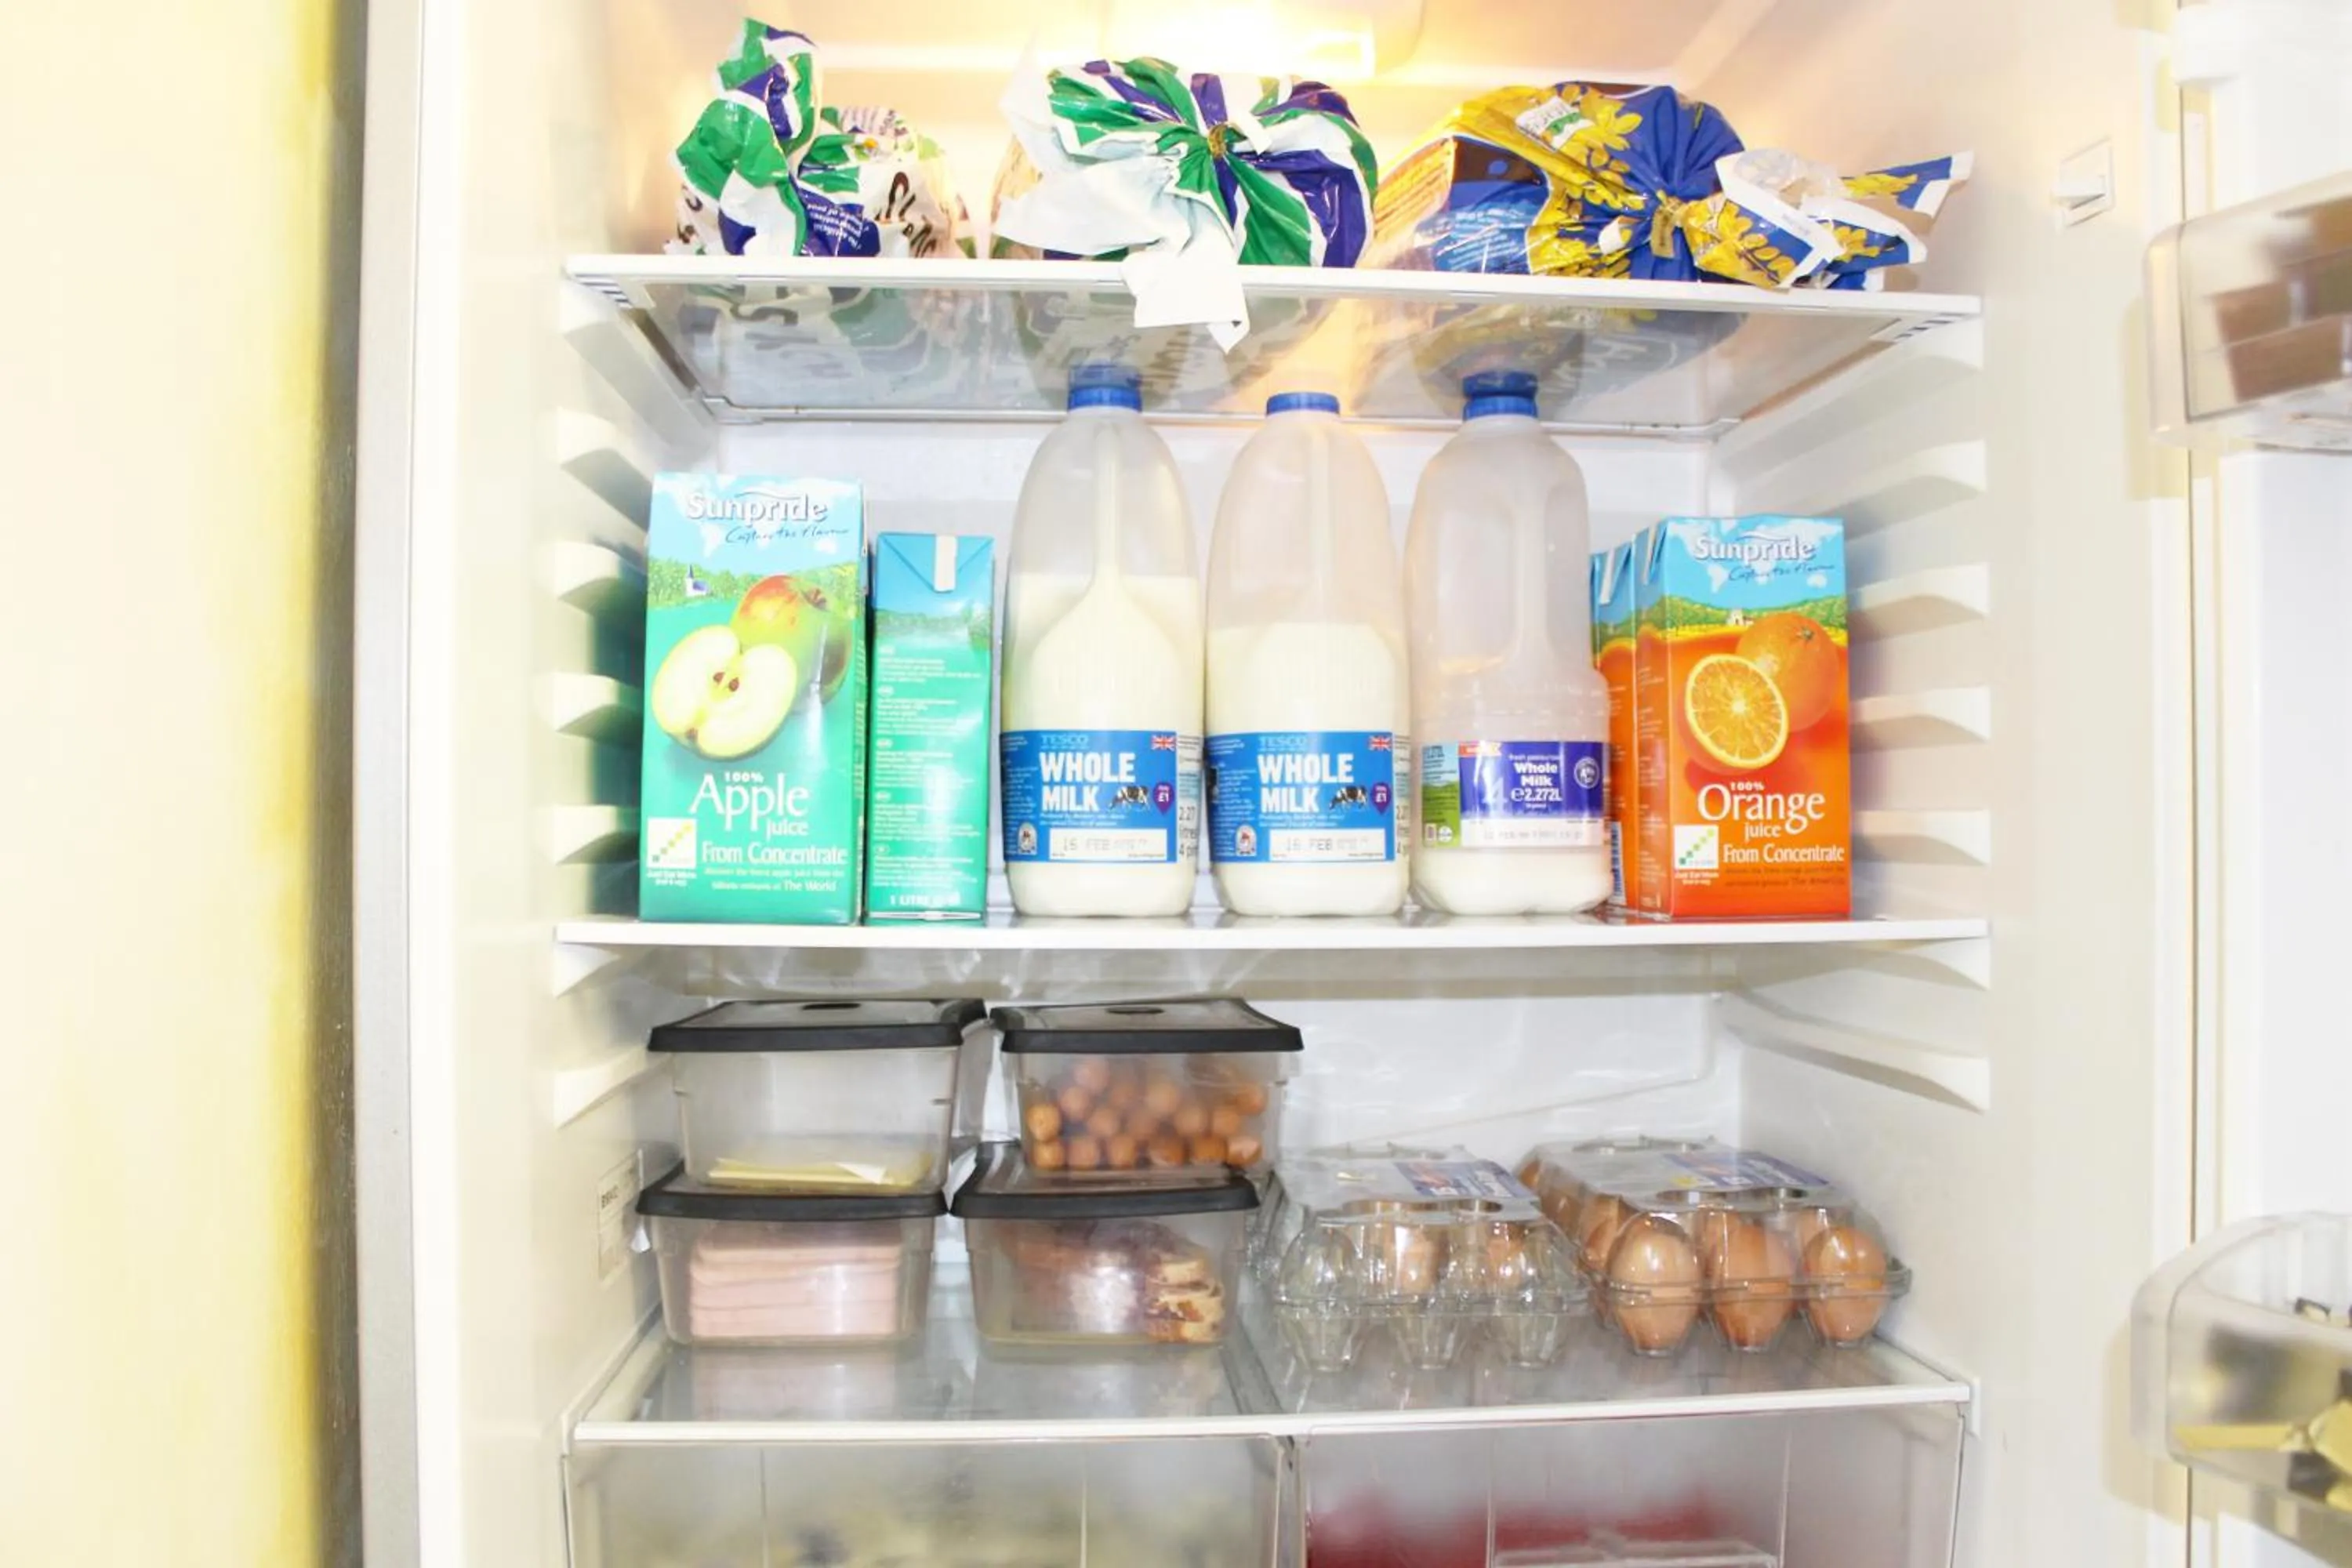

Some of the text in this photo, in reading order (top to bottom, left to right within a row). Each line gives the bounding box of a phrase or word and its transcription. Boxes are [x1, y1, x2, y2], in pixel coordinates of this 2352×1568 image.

[687, 492, 828, 528] Sunpride
[1695, 535, 1817, 568] Sunpride
[1040, 735, 1089, 744] TESCO
[1258, 736, 1308, 746] TESCO
[724, 771, 764, 782] 100%
[1040, 752, 1135, 783] WHOLE
[1258, 753, 1354, 783] WHOLE
[1513, 761, 1558, 774] Whole
[1521, 774, 1554, 786] Milk
[1730, 782, 1765, 791] 100%
[688, 772, 811, 832] Apple
[1042, 786, 1100, 813] MILK
[1261, 786, 1319, 813] MILK
[1697, 782, 1825, 835] Orange
[766, 818, 809, 841] juice
[1745, 823, 1781, 843] juice
[702, 841, 848, 865] From Concentrate
[1723, 843, 1845, 863] From Concentrate
